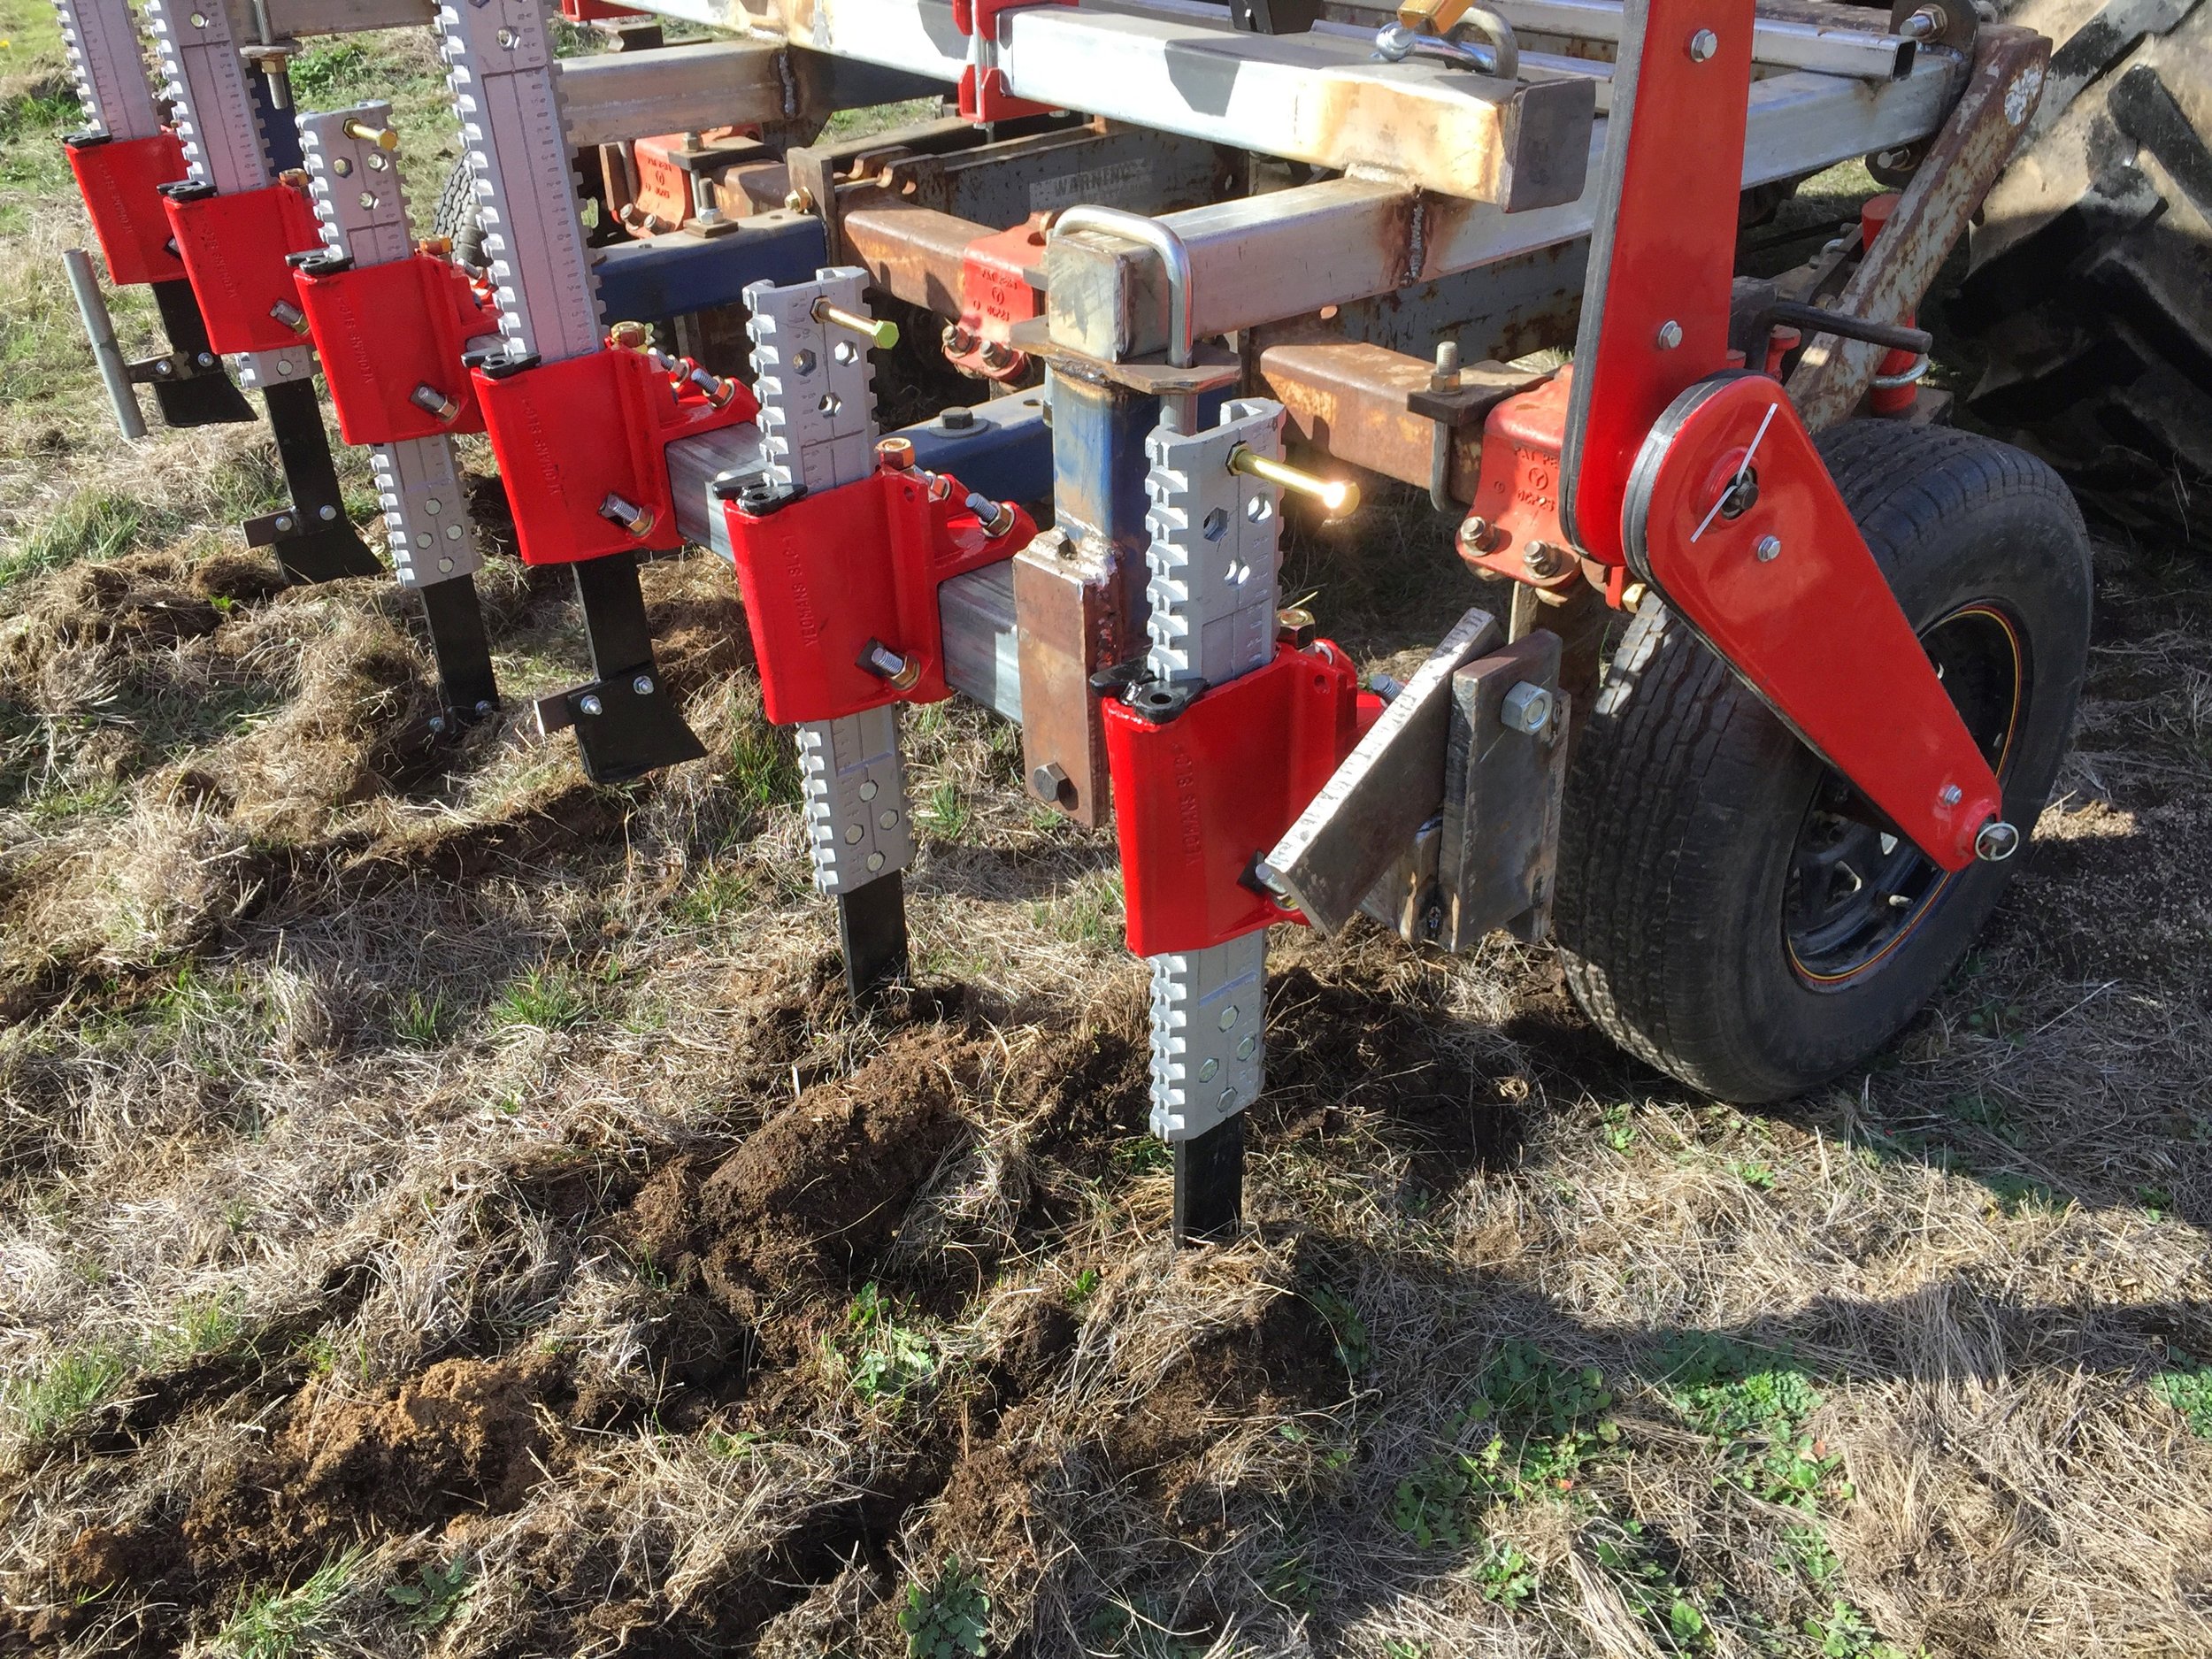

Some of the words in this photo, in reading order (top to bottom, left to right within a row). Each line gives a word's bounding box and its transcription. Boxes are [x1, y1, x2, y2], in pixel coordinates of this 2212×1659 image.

[1056, 165, 1134, 196] WARNING
[792, 582, 819, 648] YEOMANS
[1179, 793, 1203, 867] YEOMANS
